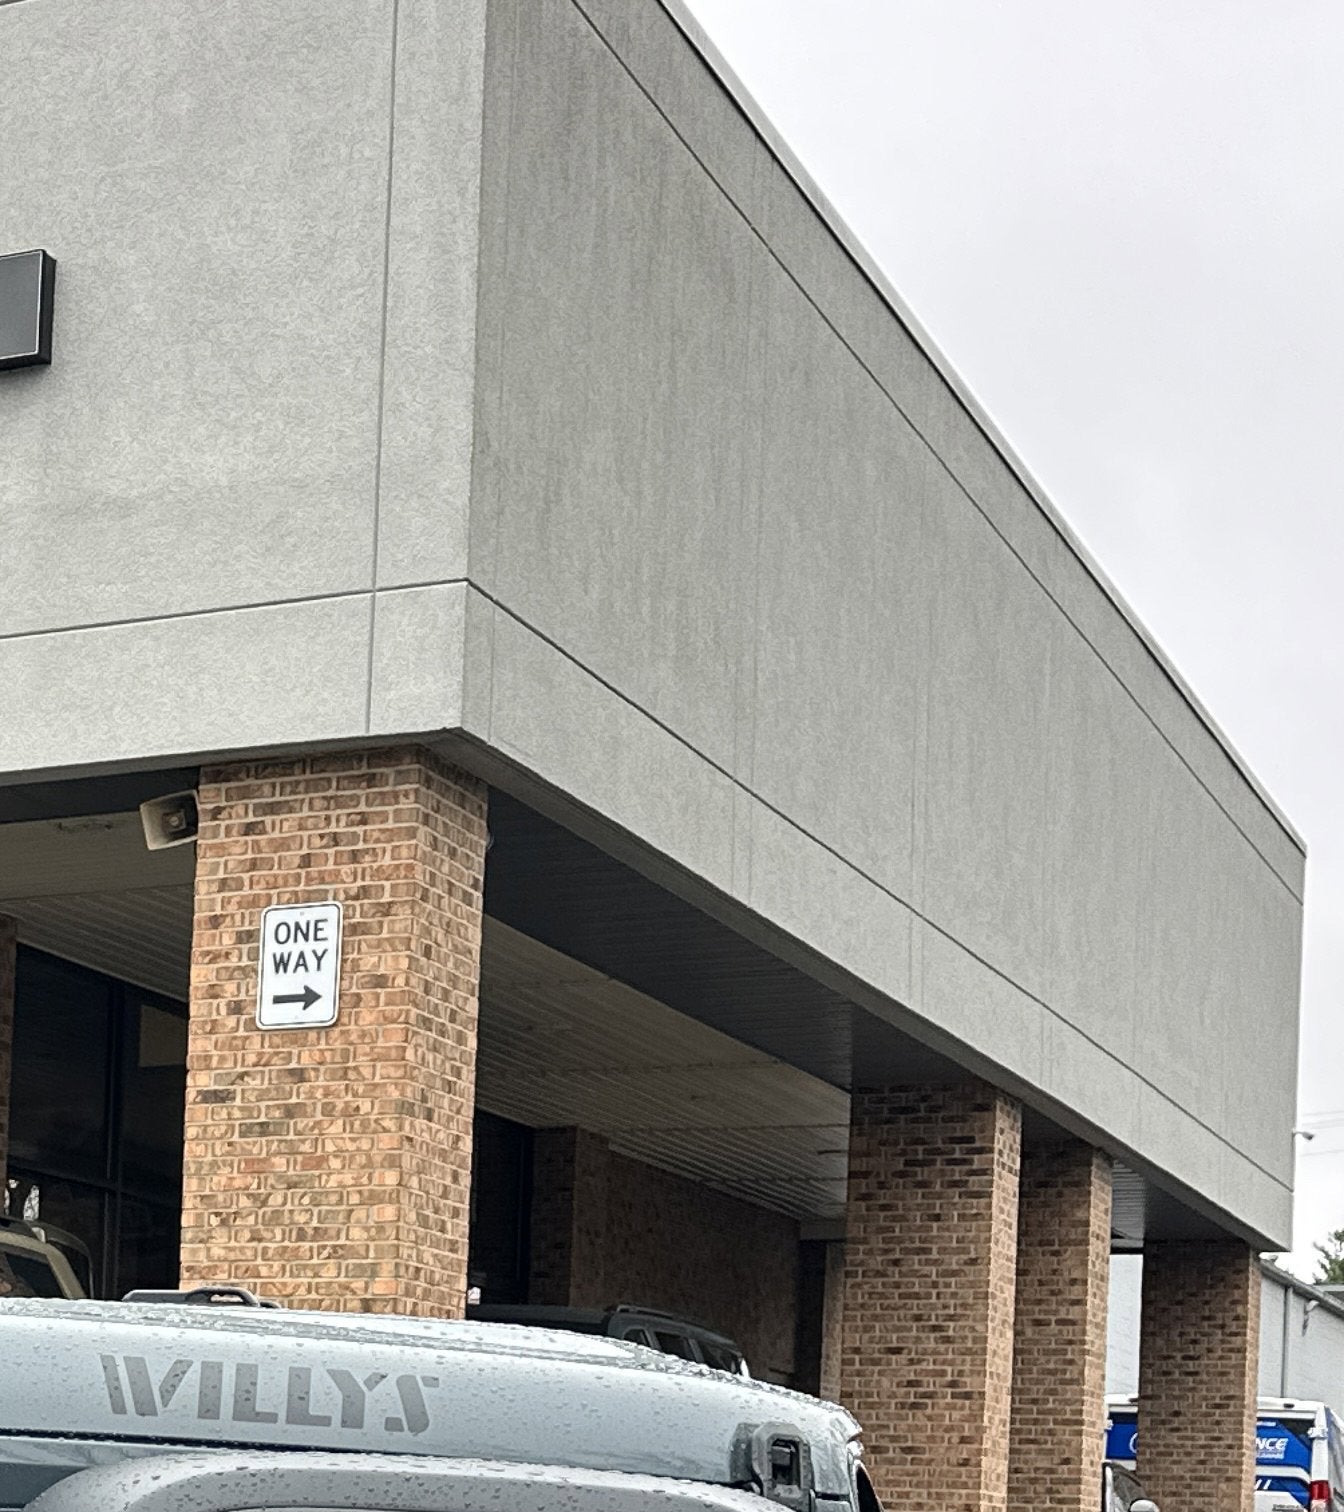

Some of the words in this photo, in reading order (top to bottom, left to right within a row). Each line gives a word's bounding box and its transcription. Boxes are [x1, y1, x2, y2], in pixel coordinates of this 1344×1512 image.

[274, 918, 328, 945] ONE
[272, 948, 328, 975] WAY
[100, 1353, 440, 1434] WILLYS
